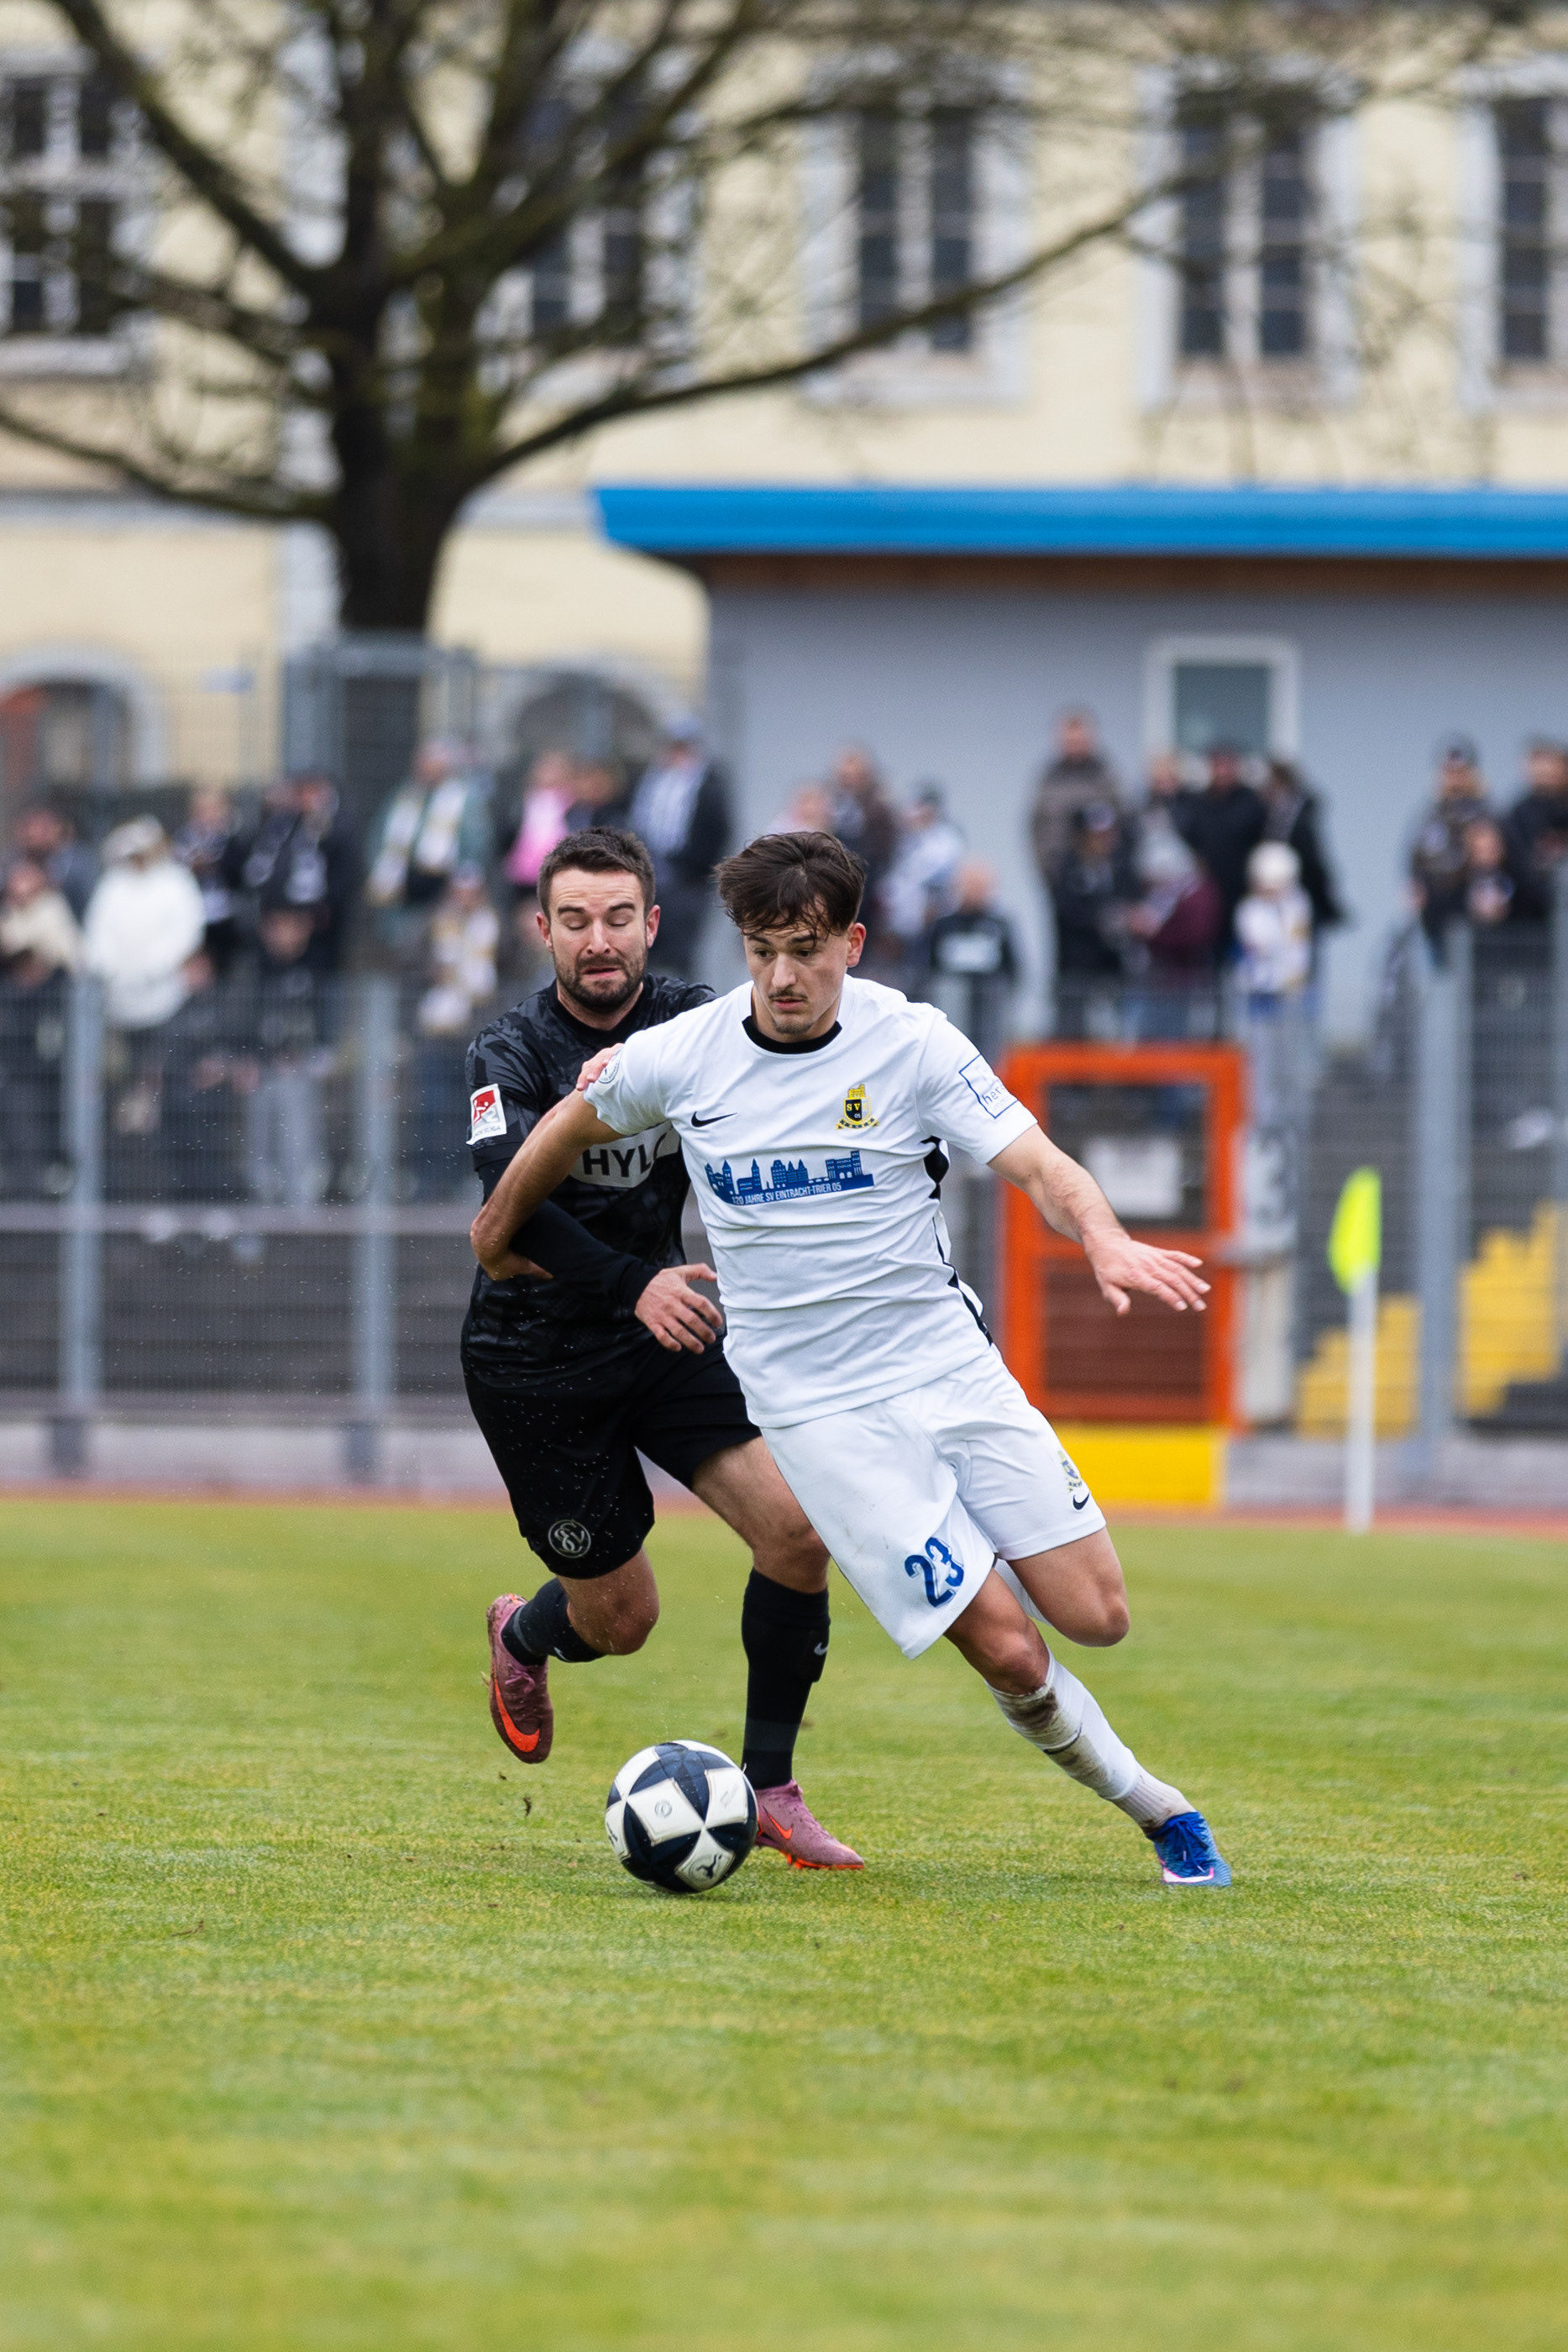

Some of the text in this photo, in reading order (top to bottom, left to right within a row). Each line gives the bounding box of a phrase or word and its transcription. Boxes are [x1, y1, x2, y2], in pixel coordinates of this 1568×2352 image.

[982, 1086, 1004, 1105] her
[732, 1182, 842, 1205] 120 JAHRE SV EINTRACHT-TRIER 05
[904, 1536, 964, 1608] 23
